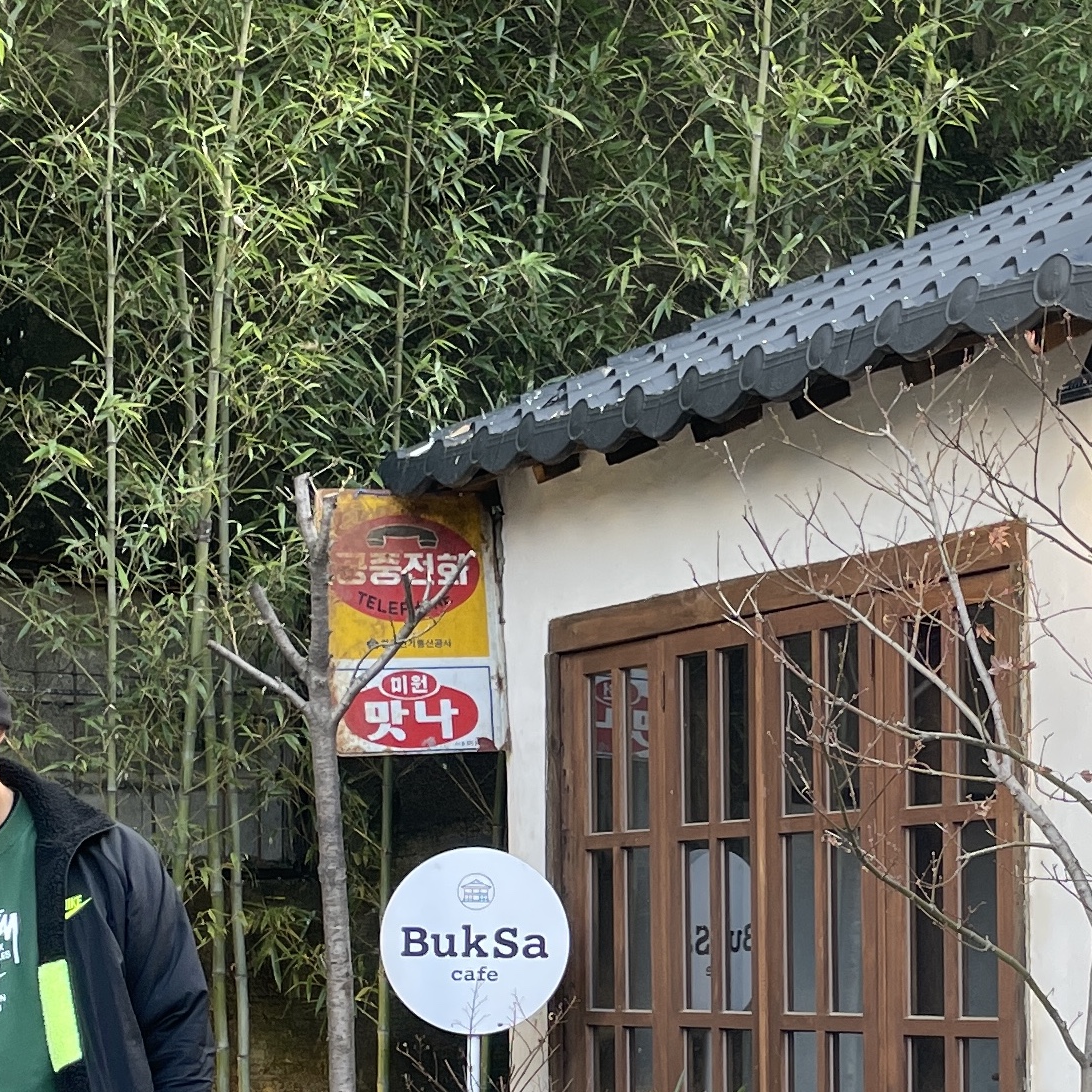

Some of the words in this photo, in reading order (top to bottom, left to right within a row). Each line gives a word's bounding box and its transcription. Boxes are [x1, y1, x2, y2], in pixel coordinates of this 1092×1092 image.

[336, 552, 470, 586] 공중전화
[391, 675, 428, 695] 미원
[364, 699, 459, 741] 맛나
[401, 924, 549, 959] BukSa
[451, 966, 498, 982] cafe
